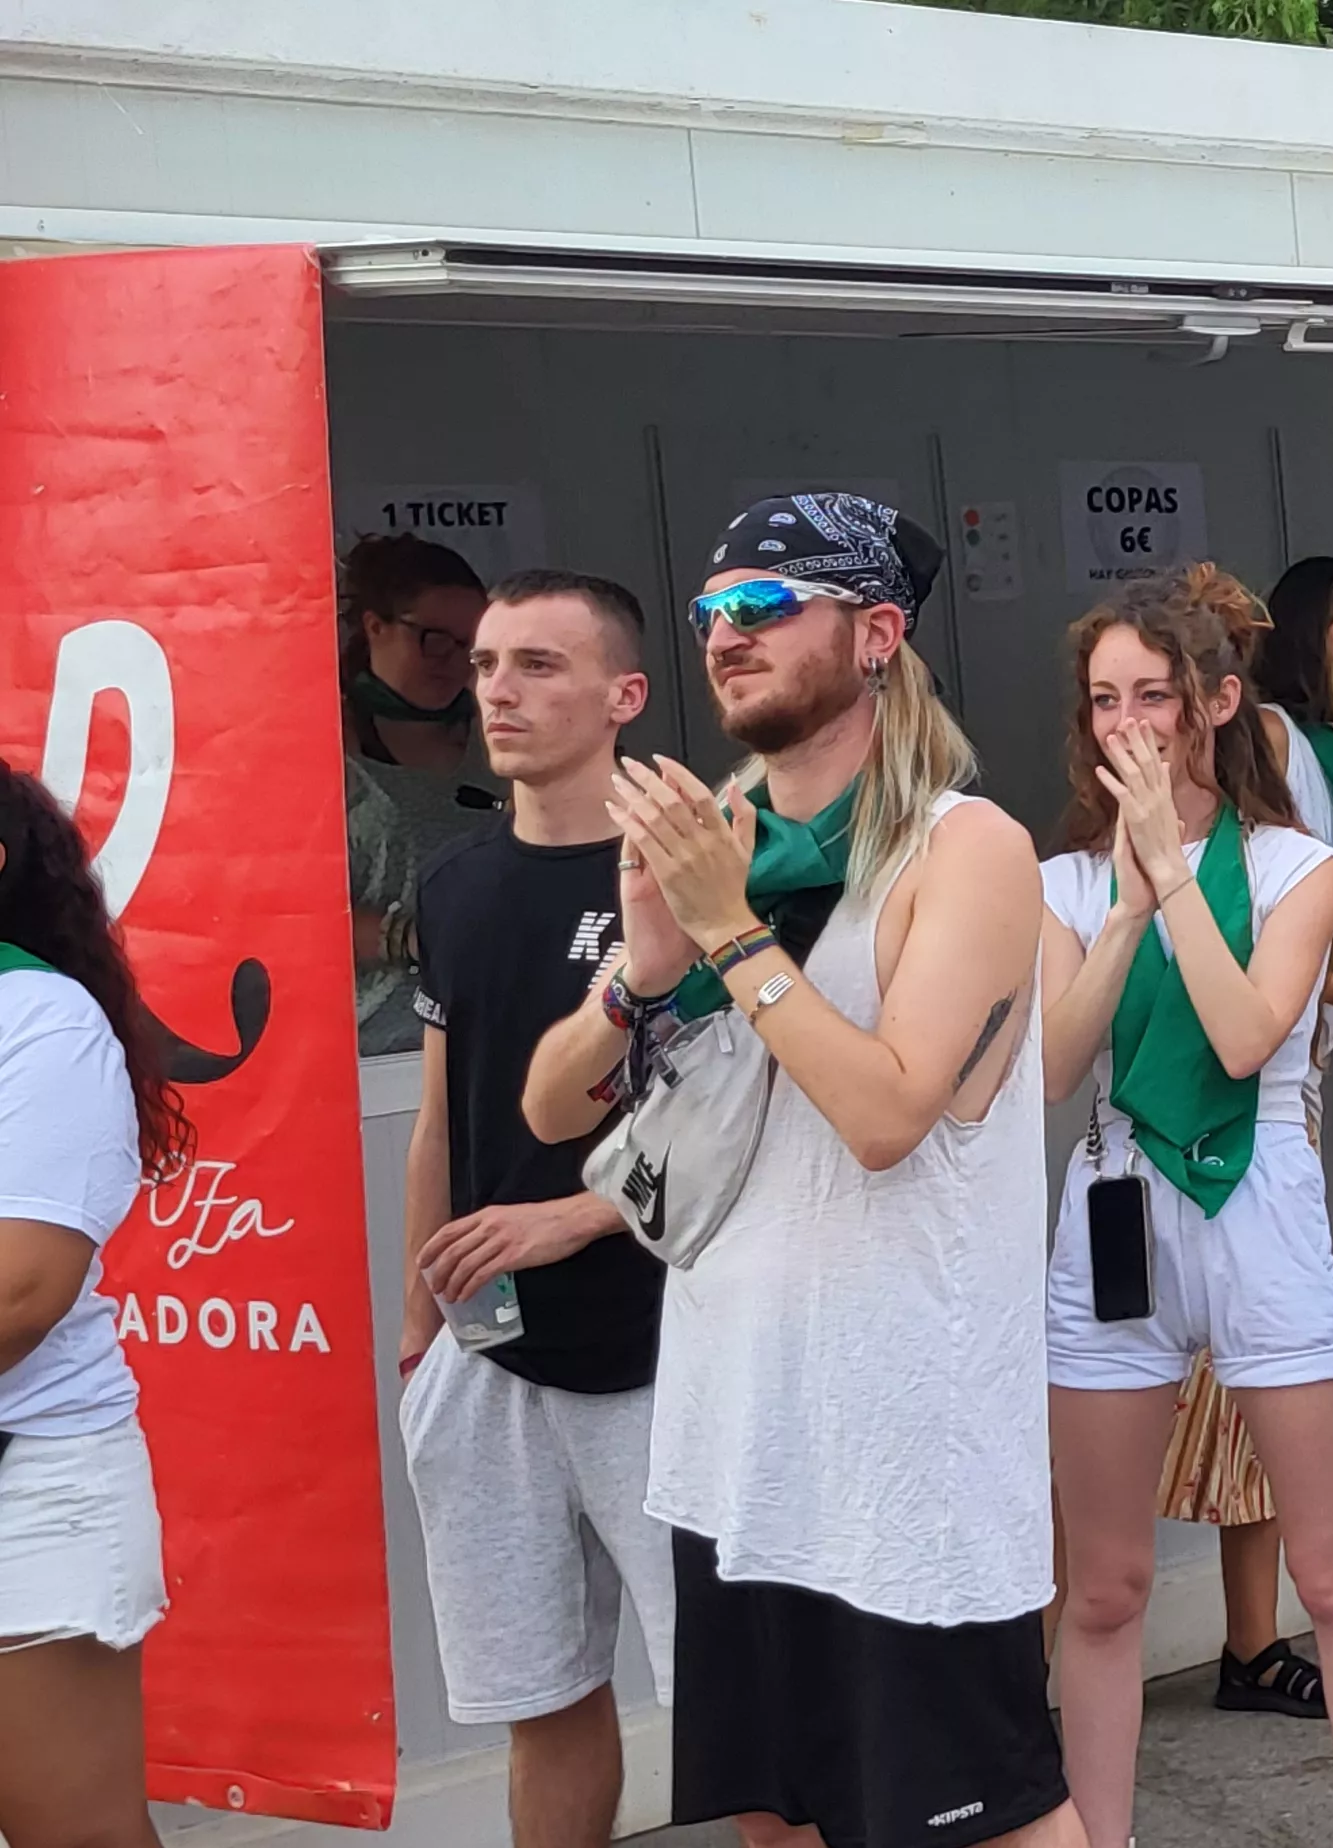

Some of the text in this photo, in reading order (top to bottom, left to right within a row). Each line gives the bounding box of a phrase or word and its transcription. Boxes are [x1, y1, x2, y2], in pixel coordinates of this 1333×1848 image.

[1086, 486, 1179, 514] COPAS
[382, 502, 508, 528] 1 TICKET
[1119, 526, 1153, 553] 6€
[621, 1150, 662, 1217] NIKE
[117, 1292, 332, 1354] ADORA
